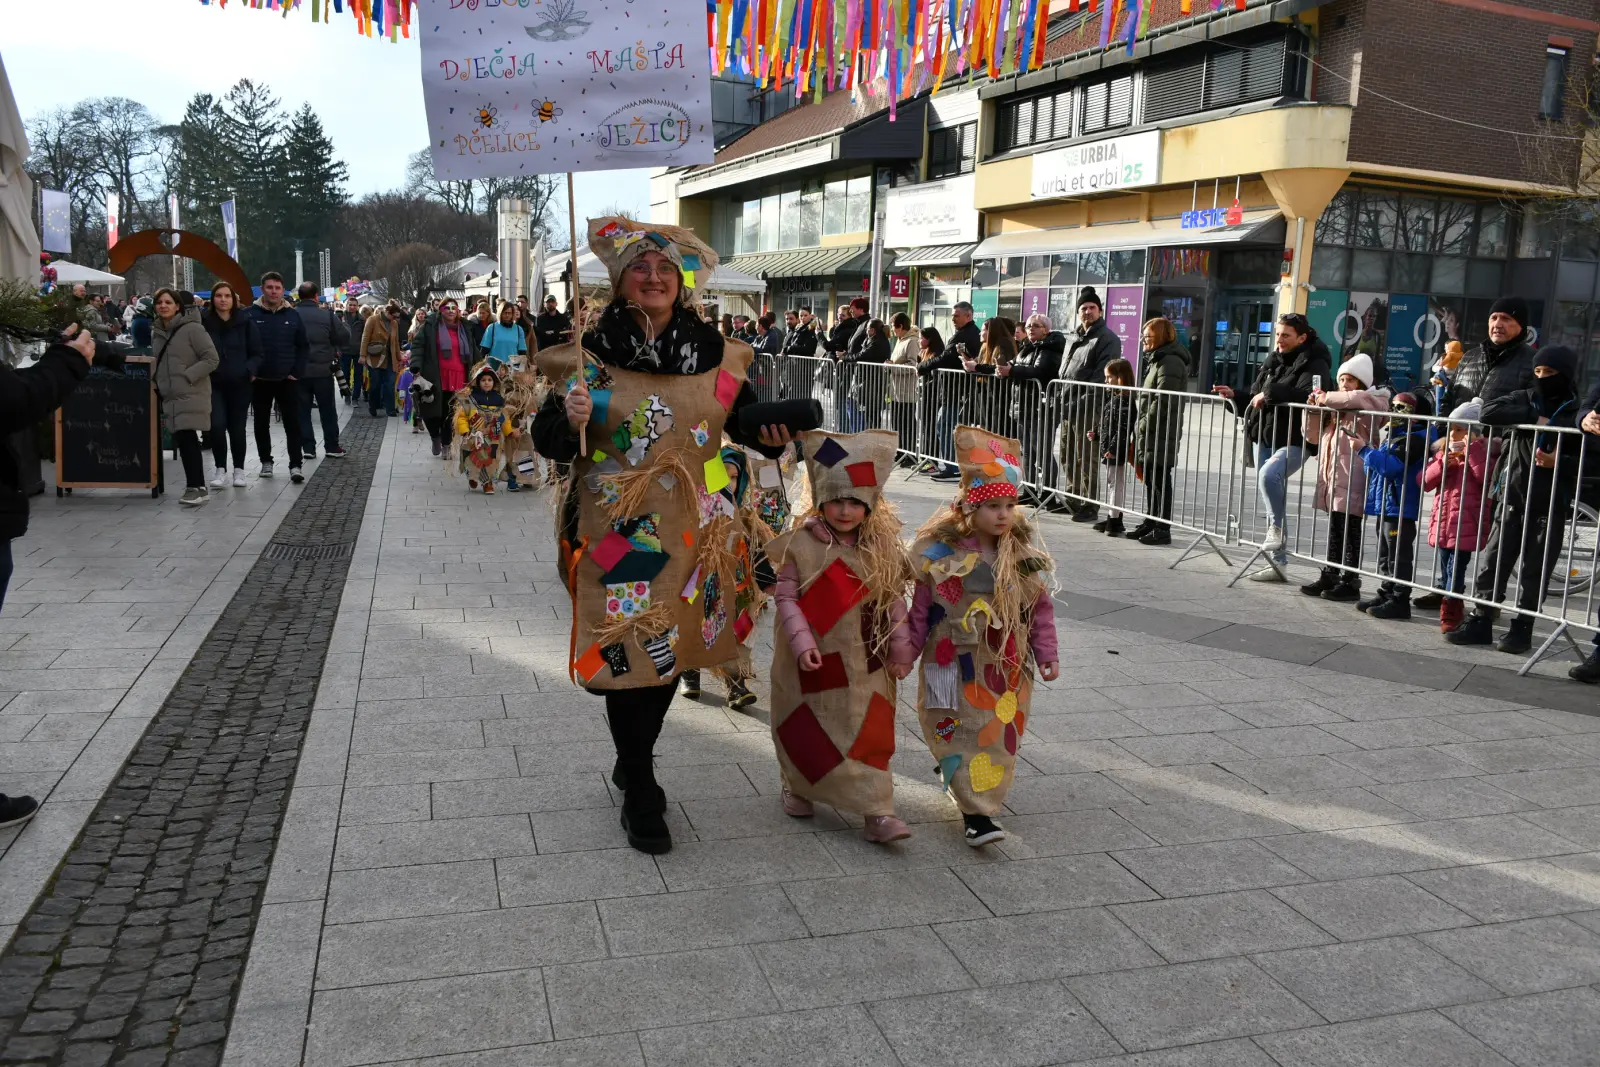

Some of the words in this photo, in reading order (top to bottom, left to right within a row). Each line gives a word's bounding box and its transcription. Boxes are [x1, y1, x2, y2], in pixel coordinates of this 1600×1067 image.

[440, 47, 538, 81] DJEČJA
[586, 40, 685, 74] MAŠTA
[454, 128, 541, 155] PČELICE
[600, 112, 688, 147] JEŽIĆI
[1080, 142, 1118, 165] URBIA
[1042, 174, 1067, 194] urbi
[1071, 172, 1085, 190] et
[1089, 166, 1118, 189] orbi
[1123, 162, 1143, 183] 25
[1181, 207, 1226, 229] ERSTE
